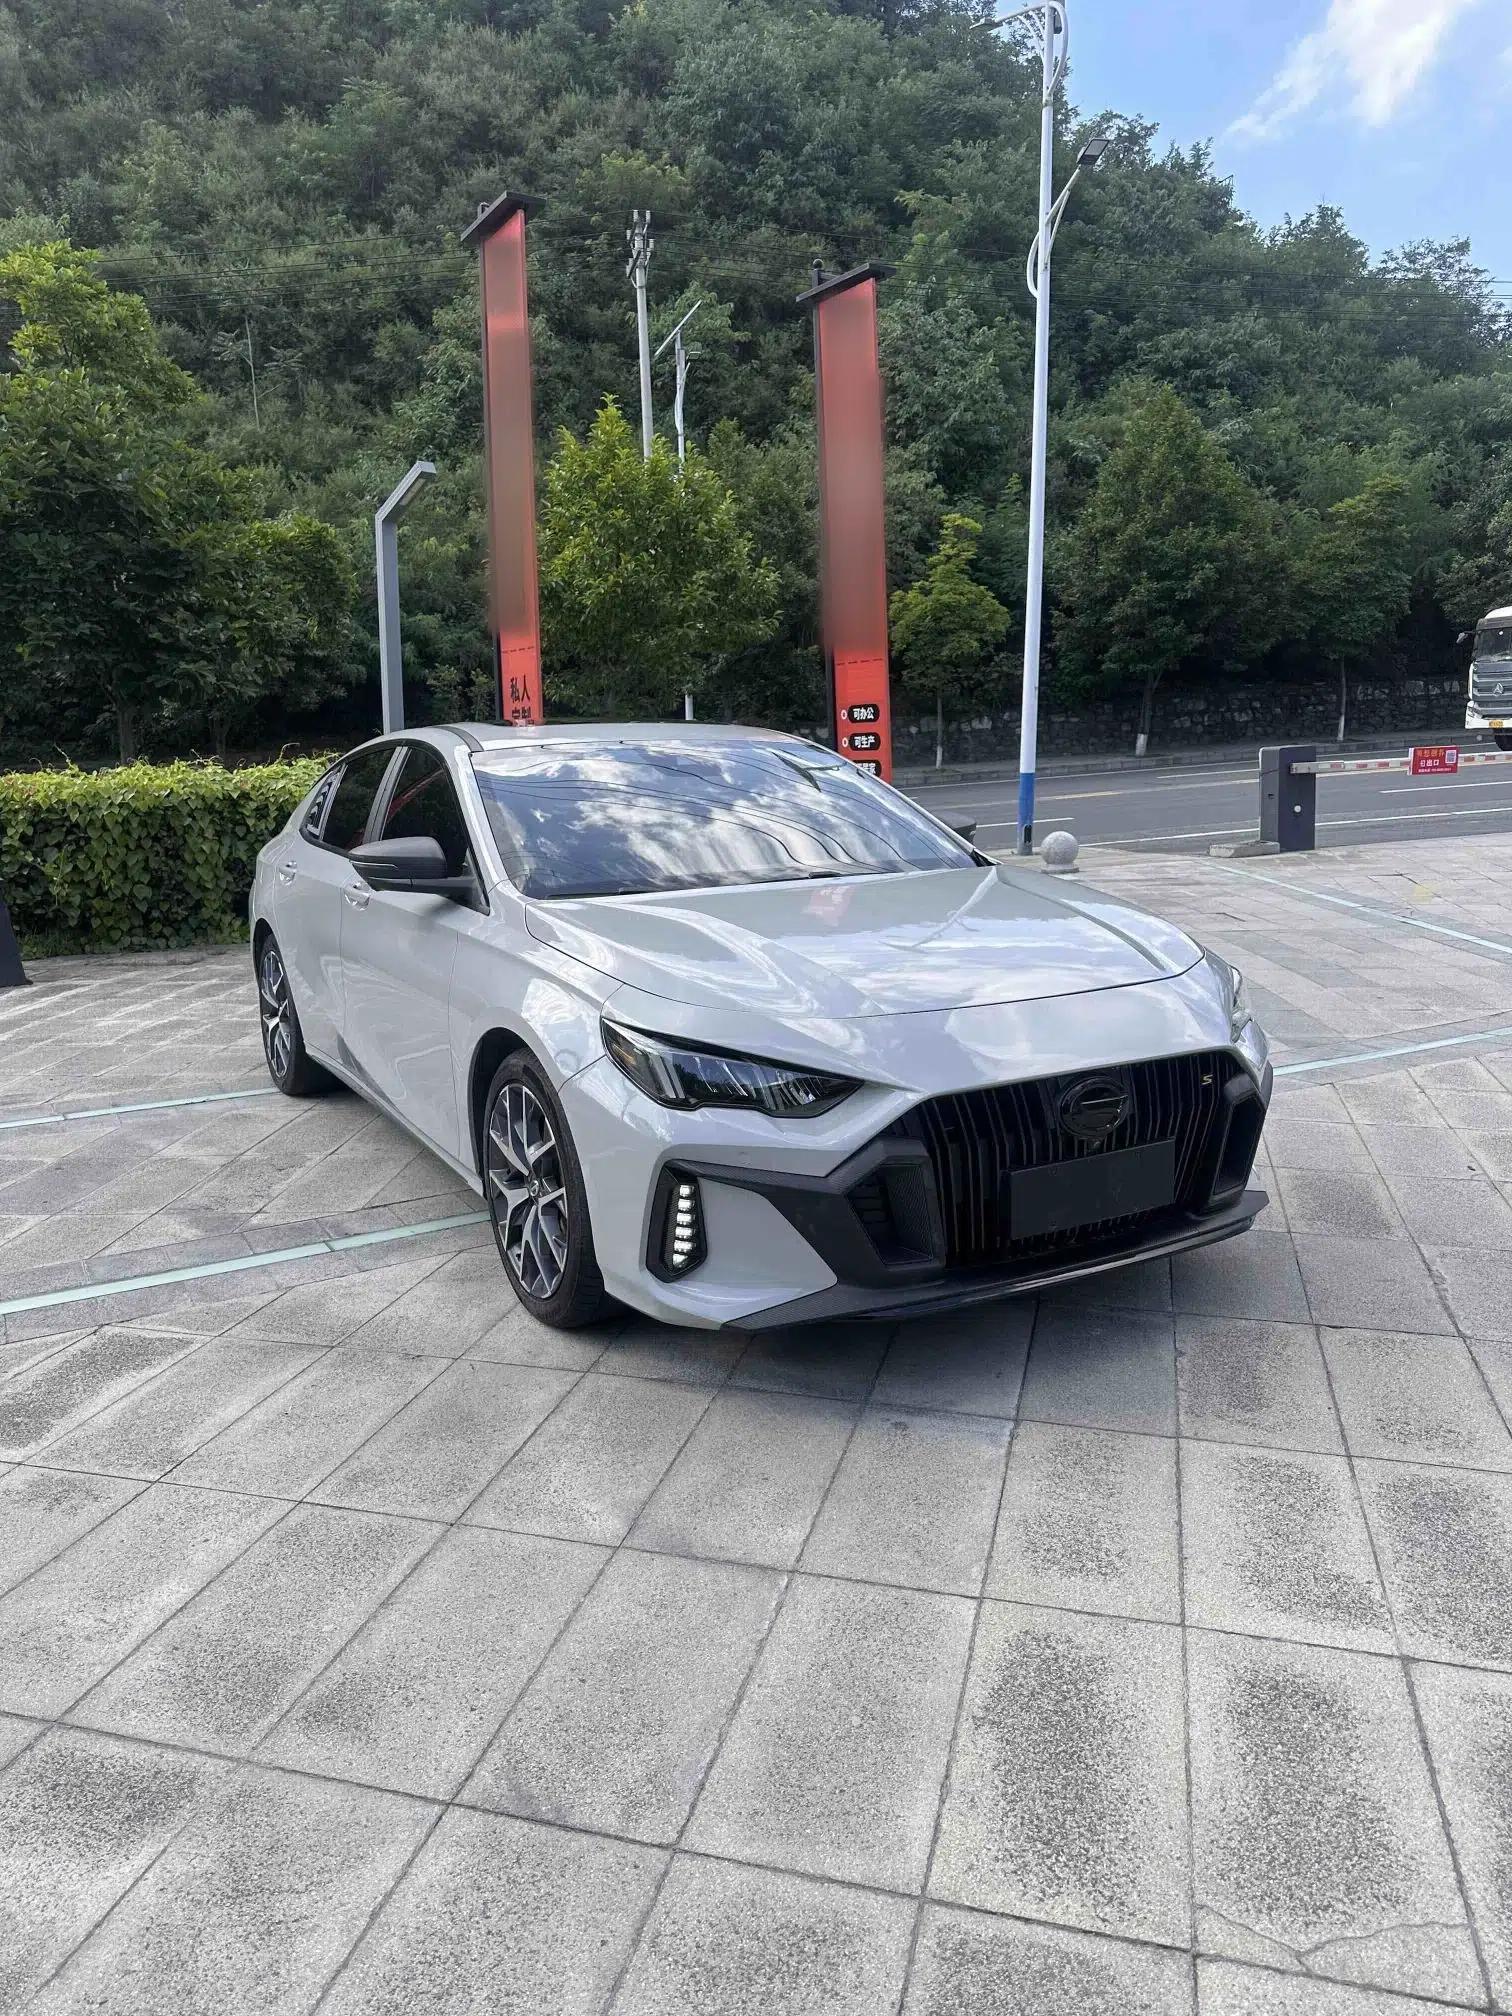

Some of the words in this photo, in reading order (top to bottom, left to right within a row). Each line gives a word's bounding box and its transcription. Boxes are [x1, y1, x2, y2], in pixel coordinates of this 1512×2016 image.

[510, 674, 530, 703] 私人
[853, 707, 874, 720] 可办公
[854, 736, 875, 748] 可生产
[1202, 1074, 1213, 1085] S
